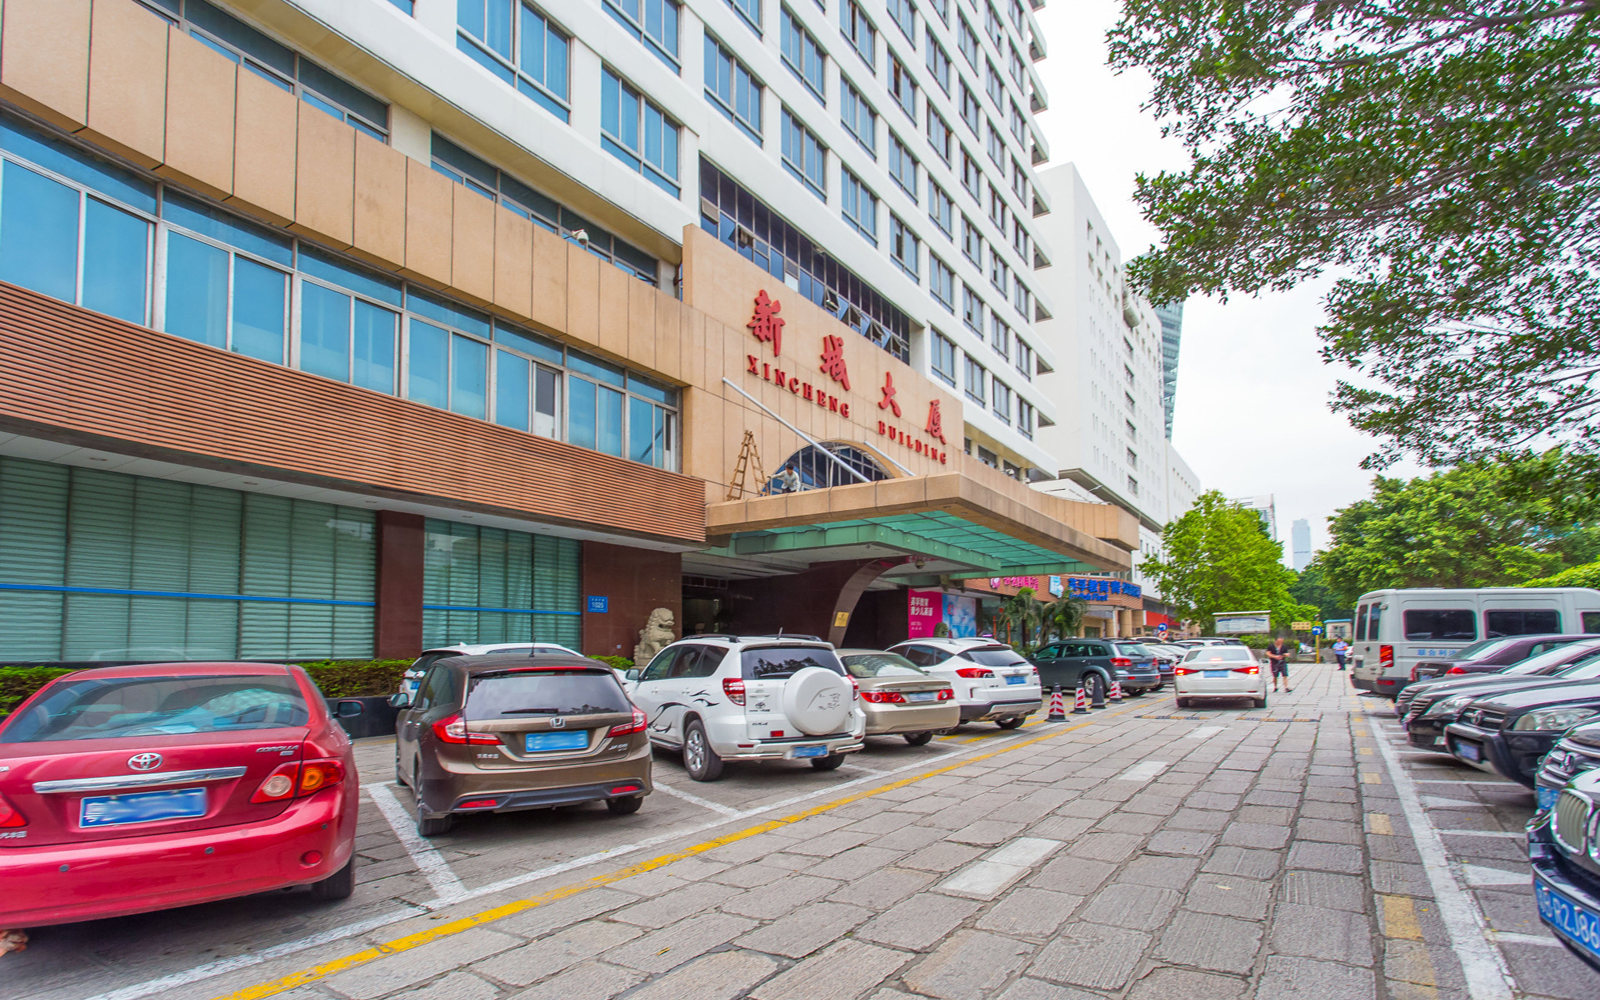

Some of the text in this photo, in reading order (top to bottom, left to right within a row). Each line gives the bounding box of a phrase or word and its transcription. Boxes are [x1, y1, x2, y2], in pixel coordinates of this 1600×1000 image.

[747, 289, 947, 445] 新城大厦
[747, 354, 947, 464] XINCHENG BUILDING
